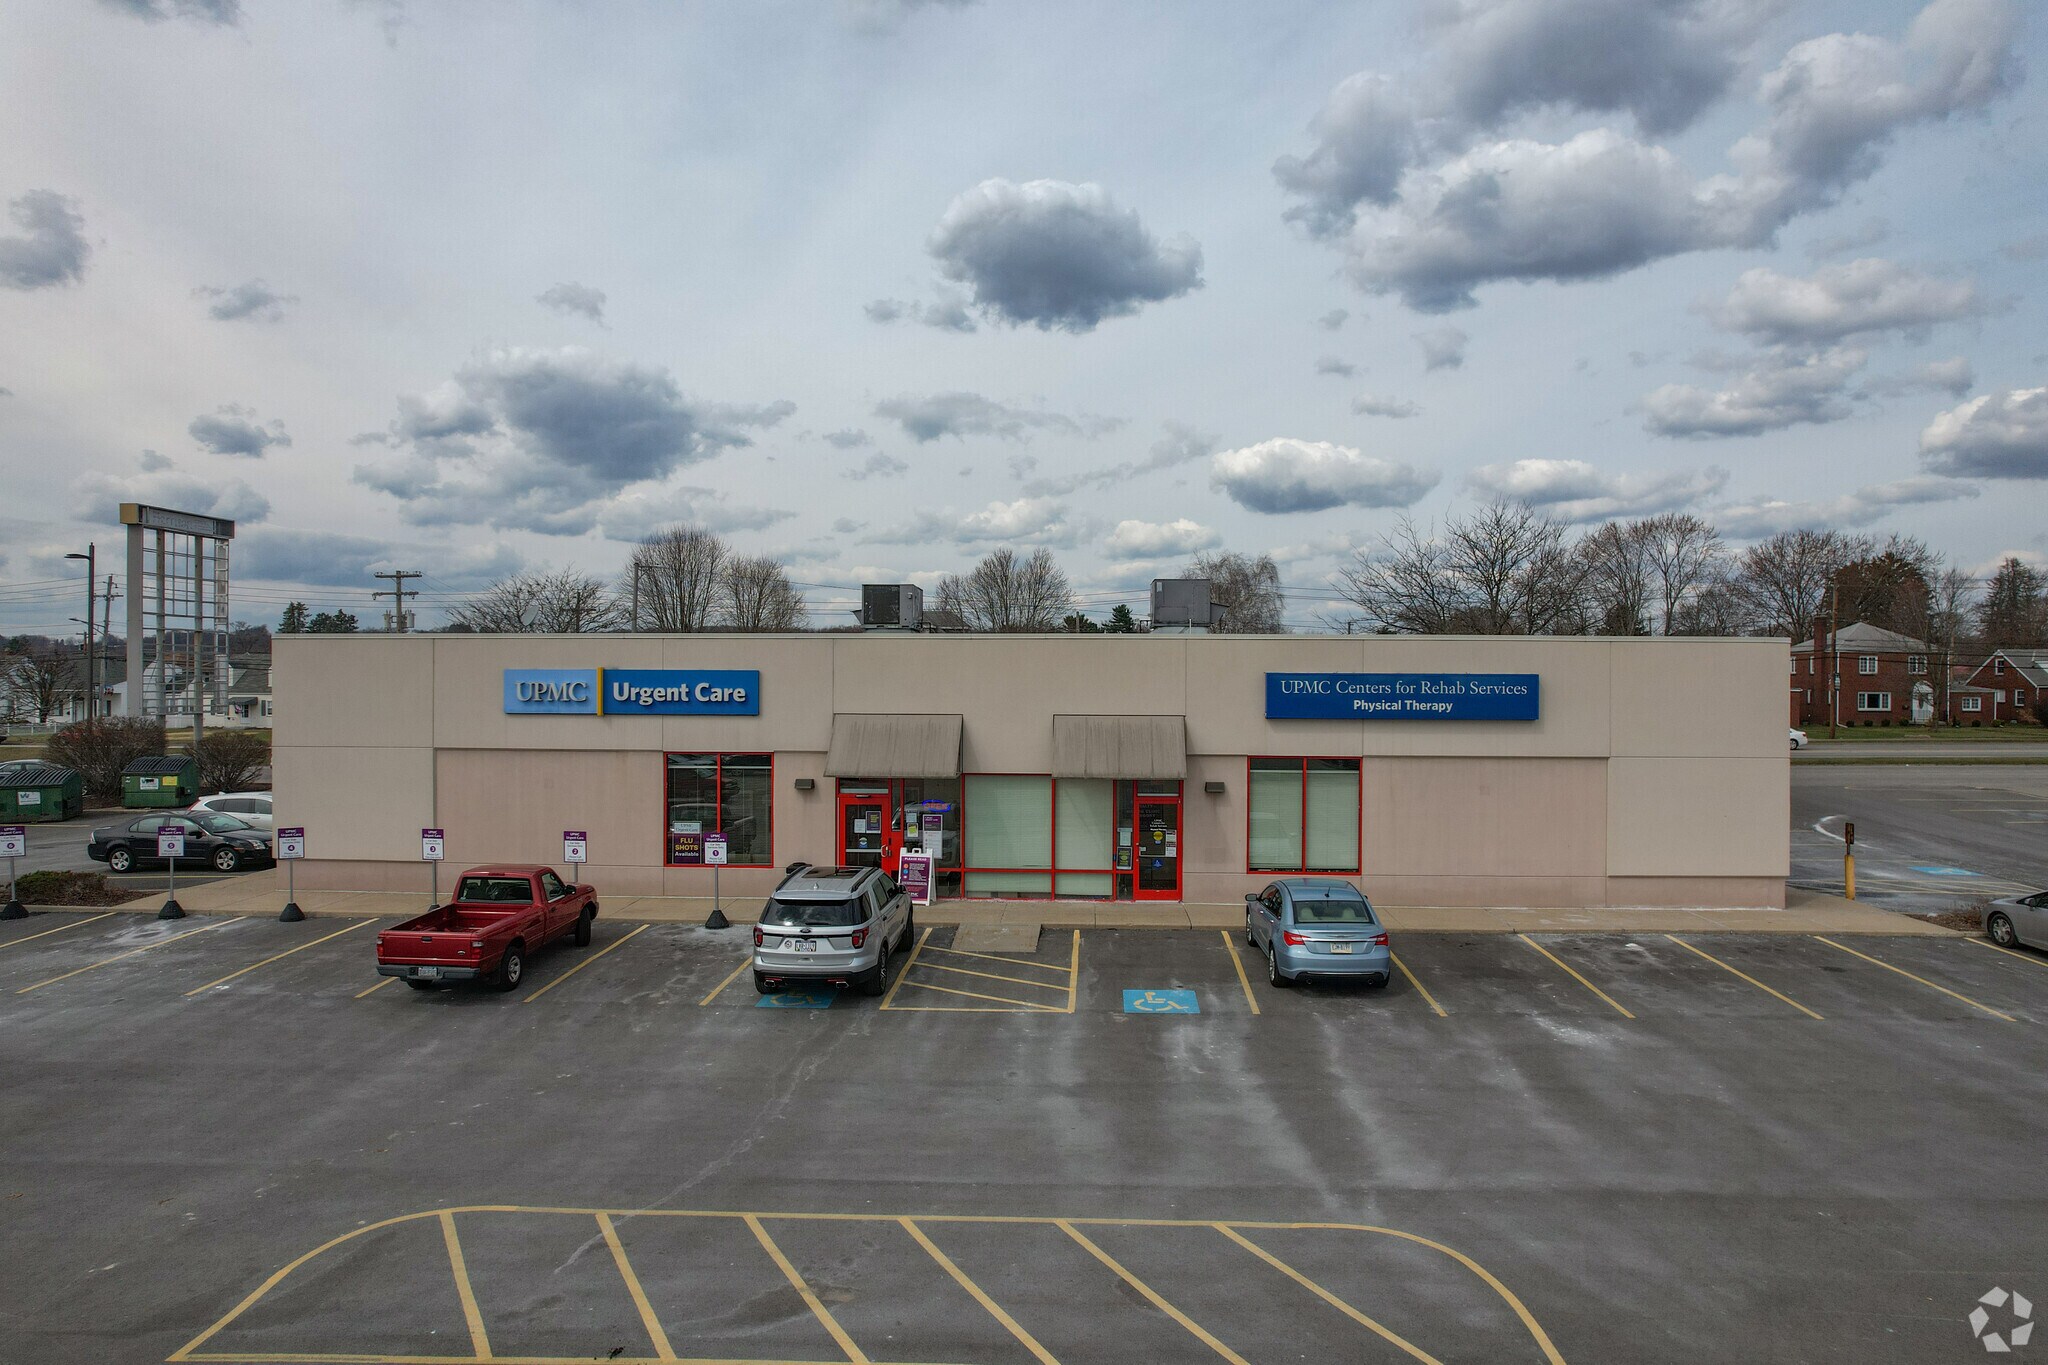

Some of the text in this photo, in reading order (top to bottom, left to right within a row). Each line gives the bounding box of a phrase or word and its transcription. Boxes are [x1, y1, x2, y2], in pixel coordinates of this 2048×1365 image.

[515, 682, 746, 706] UPMC Urgent Care
[1281, 680, 1528, 696] UPMC Centers for Rehab Services
[1353, 700, 1454, 713] Physical Therapy
